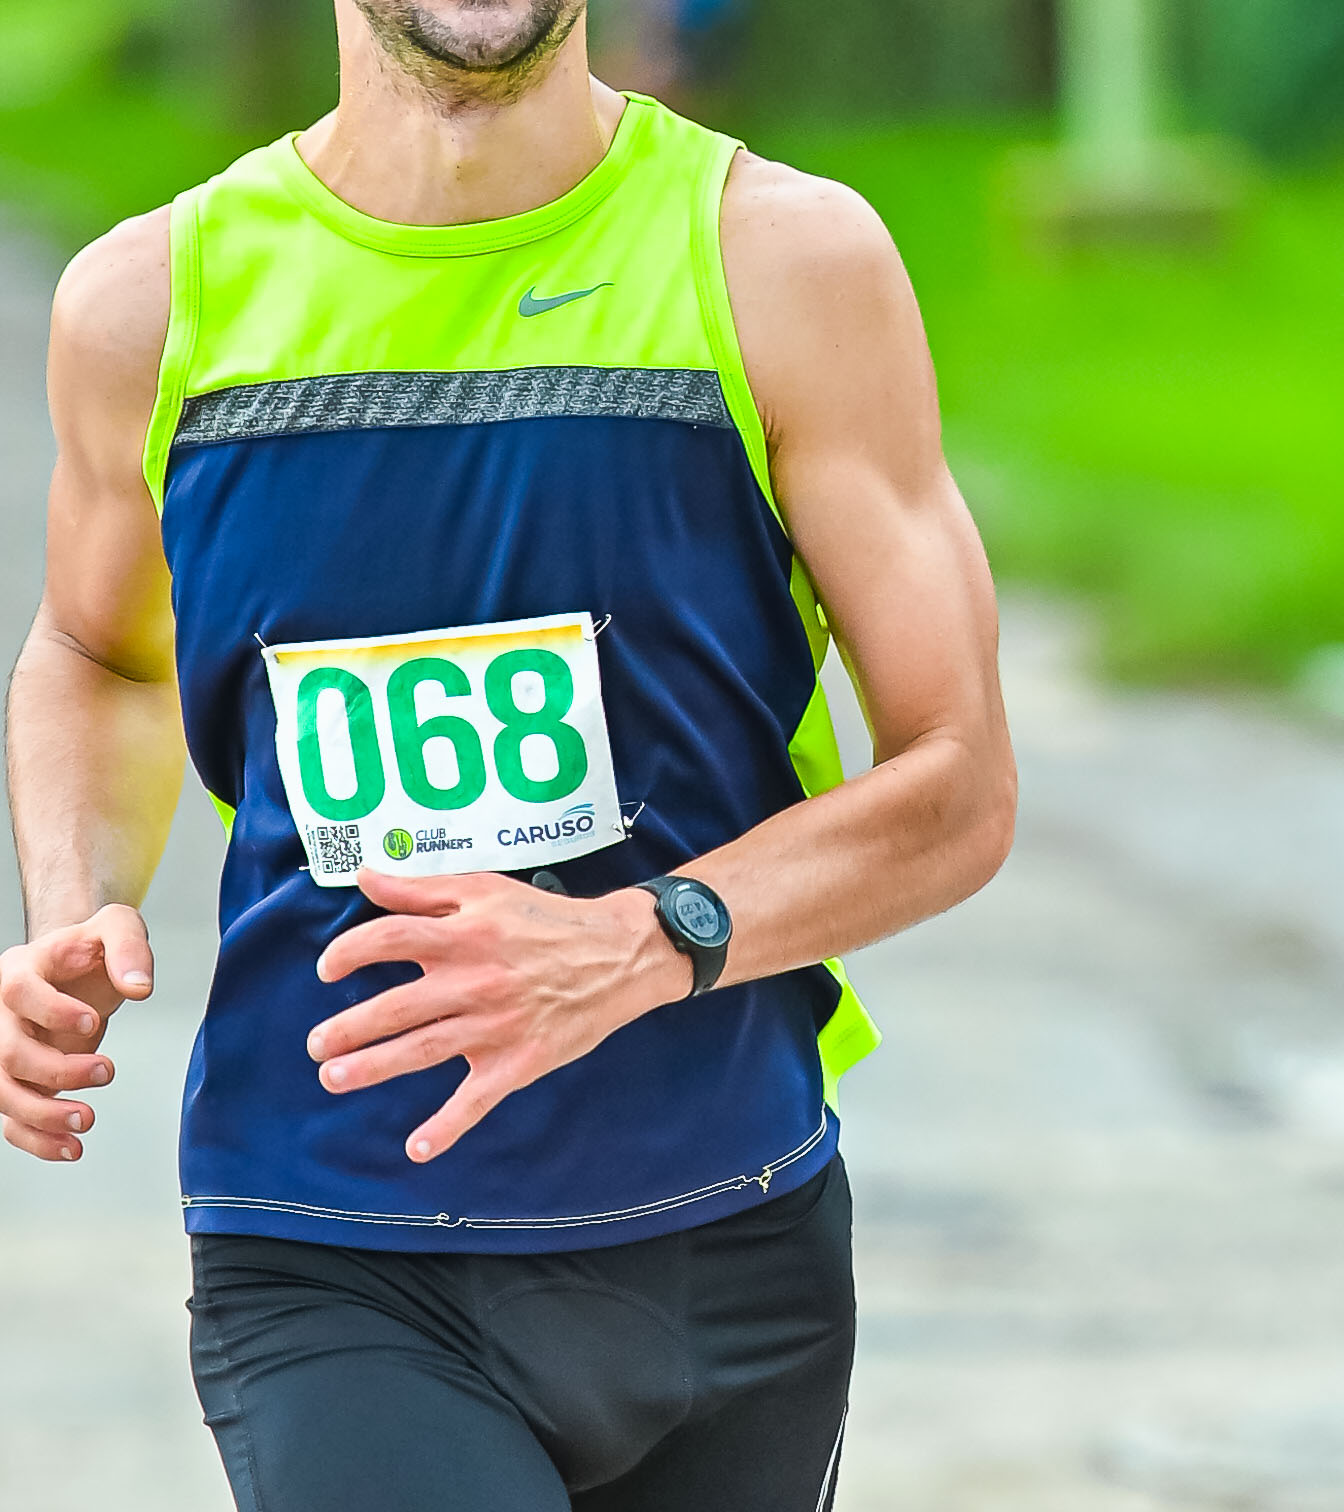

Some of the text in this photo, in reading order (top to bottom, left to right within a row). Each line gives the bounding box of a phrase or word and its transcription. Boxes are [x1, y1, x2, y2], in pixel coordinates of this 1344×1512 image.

[297, 648, 588, 821] 068
[416, 828, 446, 841] CLUB
[497, 816, 594, 846] CARUSO
[416, 838, 473, 854] RUNNER'S
